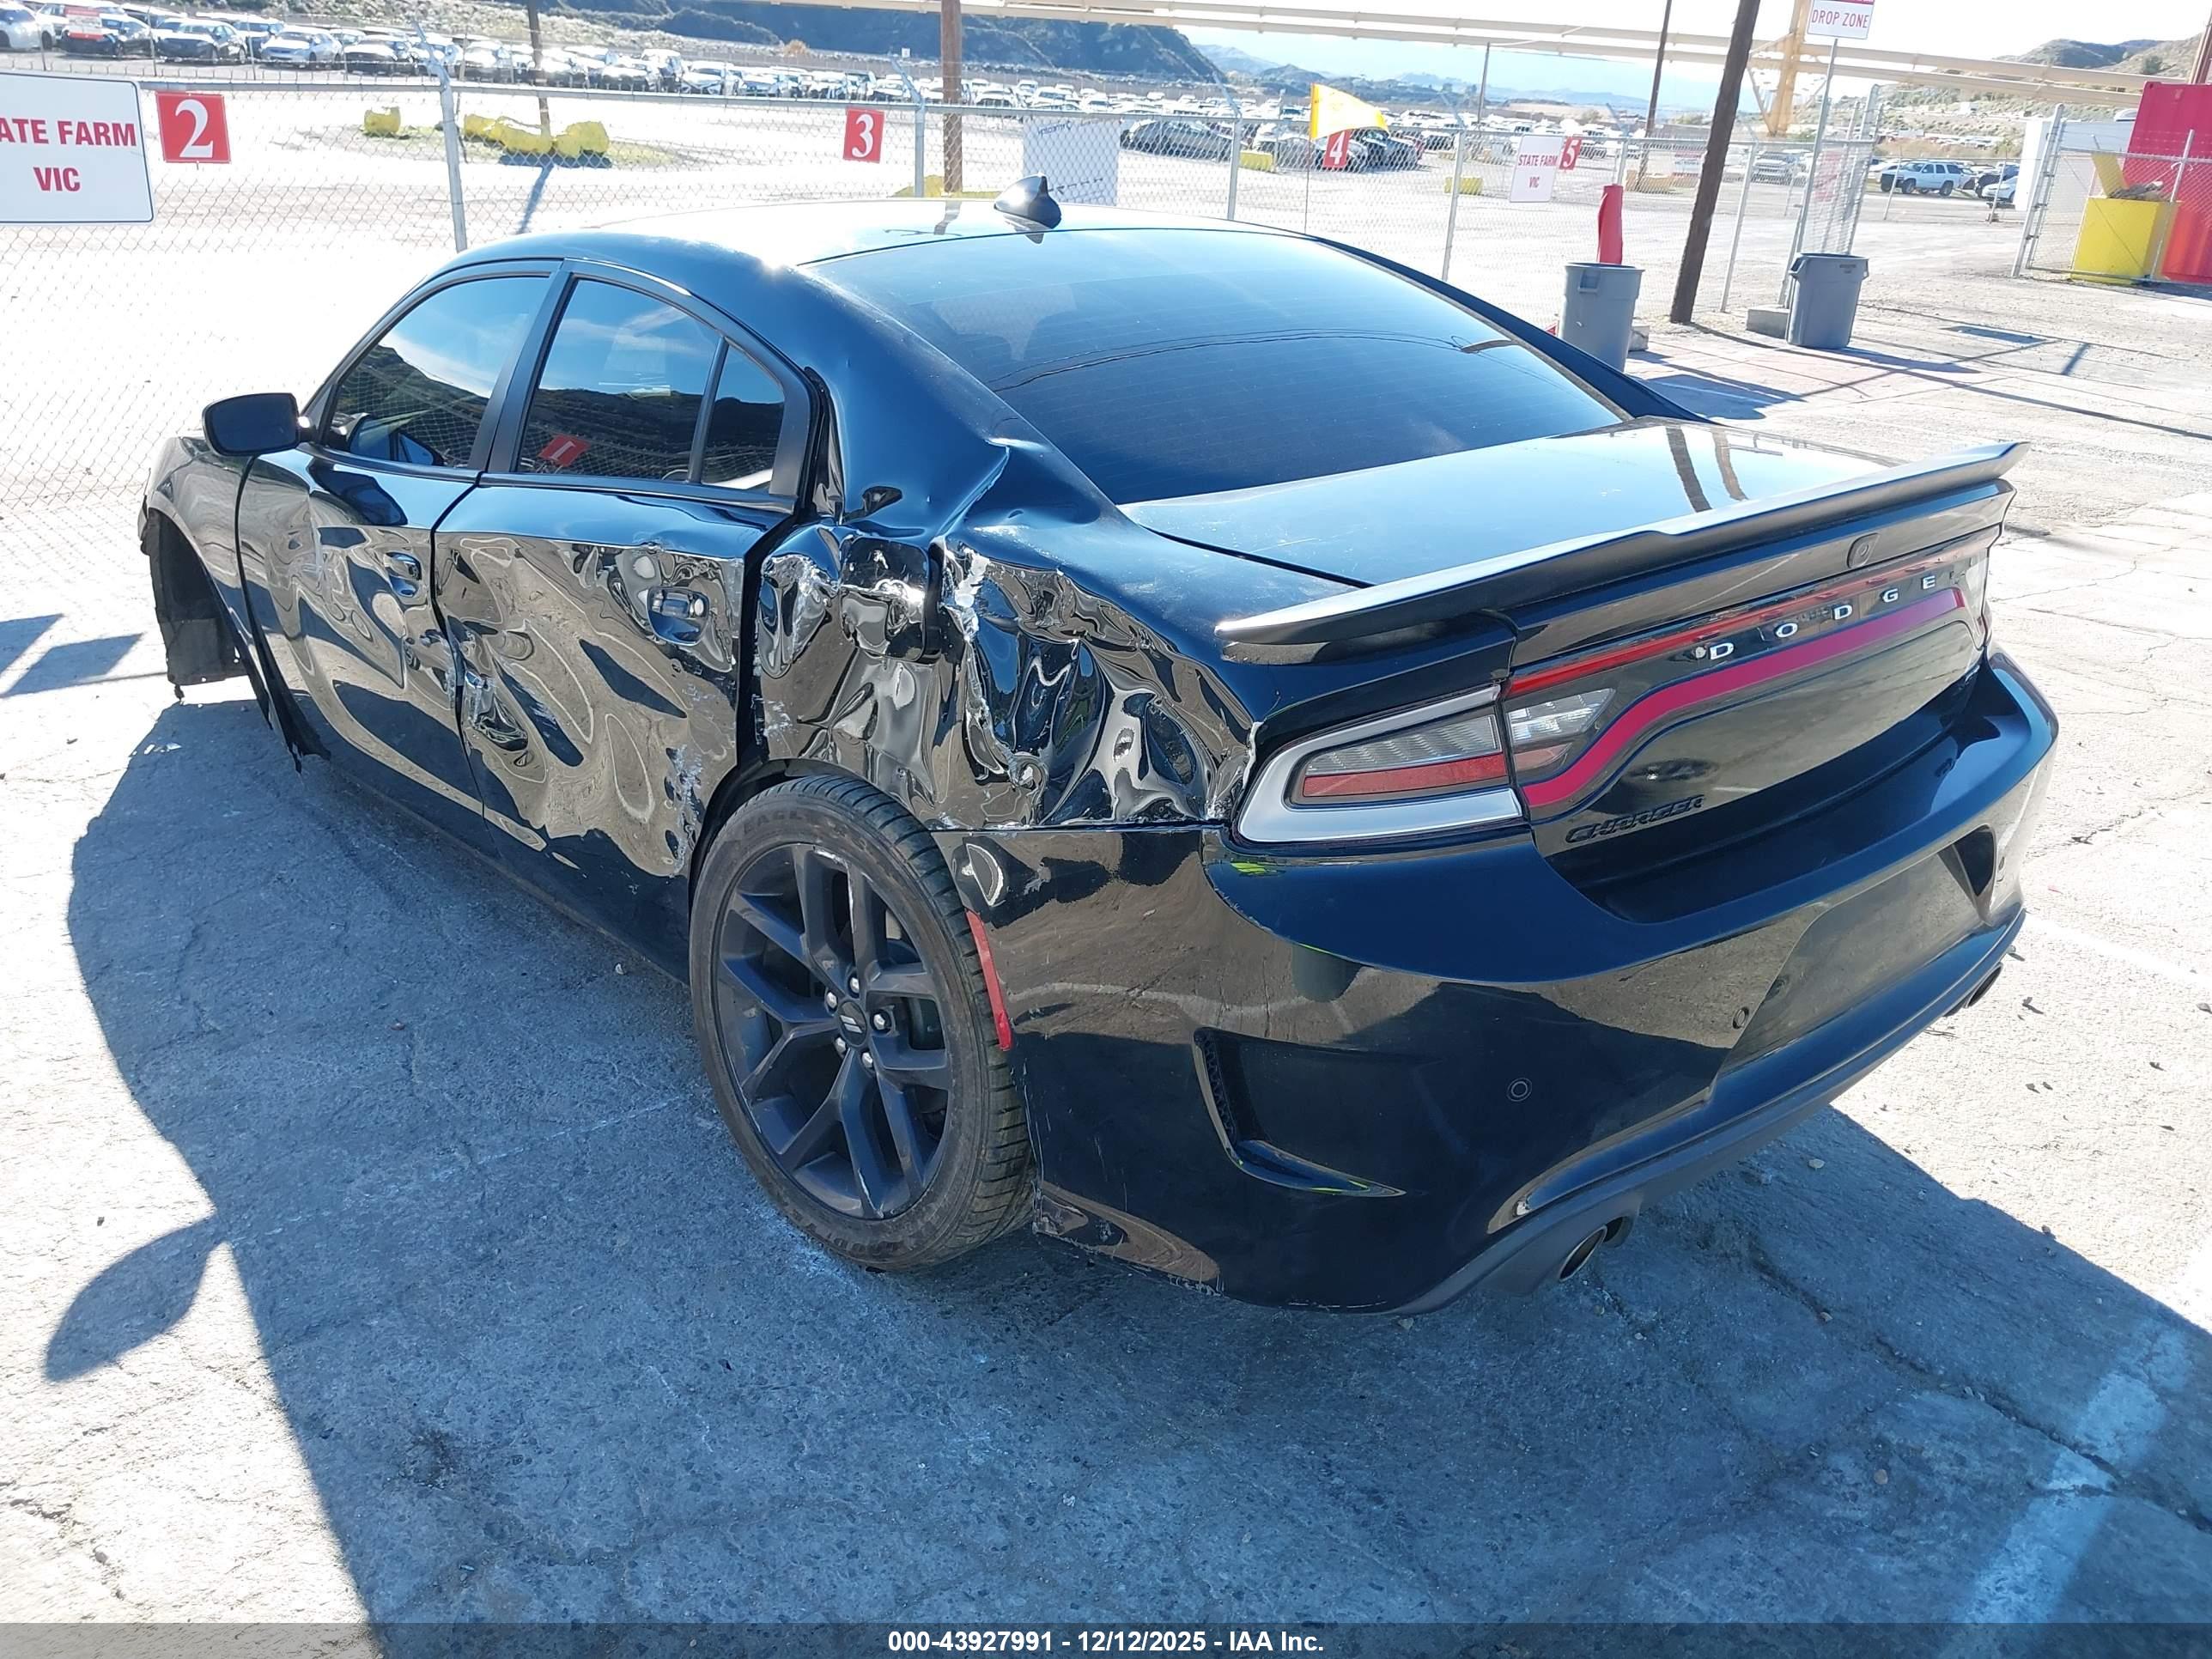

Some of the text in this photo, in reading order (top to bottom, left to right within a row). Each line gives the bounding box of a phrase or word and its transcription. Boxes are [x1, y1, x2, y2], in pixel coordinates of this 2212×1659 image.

[1812, 9, 1869, 28] DROP ZONE
[0, 118, 137, 147] ATE FARM
[175, 99, 214, 159] 2
[852, 113, 874, 157] 3
[1329, 131, 1346, 165] 4
[1518, 155, 1559, 167] STATE FARM
[1563, 139, 1579, 167] 5
[33, 167, 81, 191] VIC
[1528, 177, 1540, 188] VIC
[1709, 574, 1936, 660] DODGE
[1565, 794, 1705, 842] CHARGER
